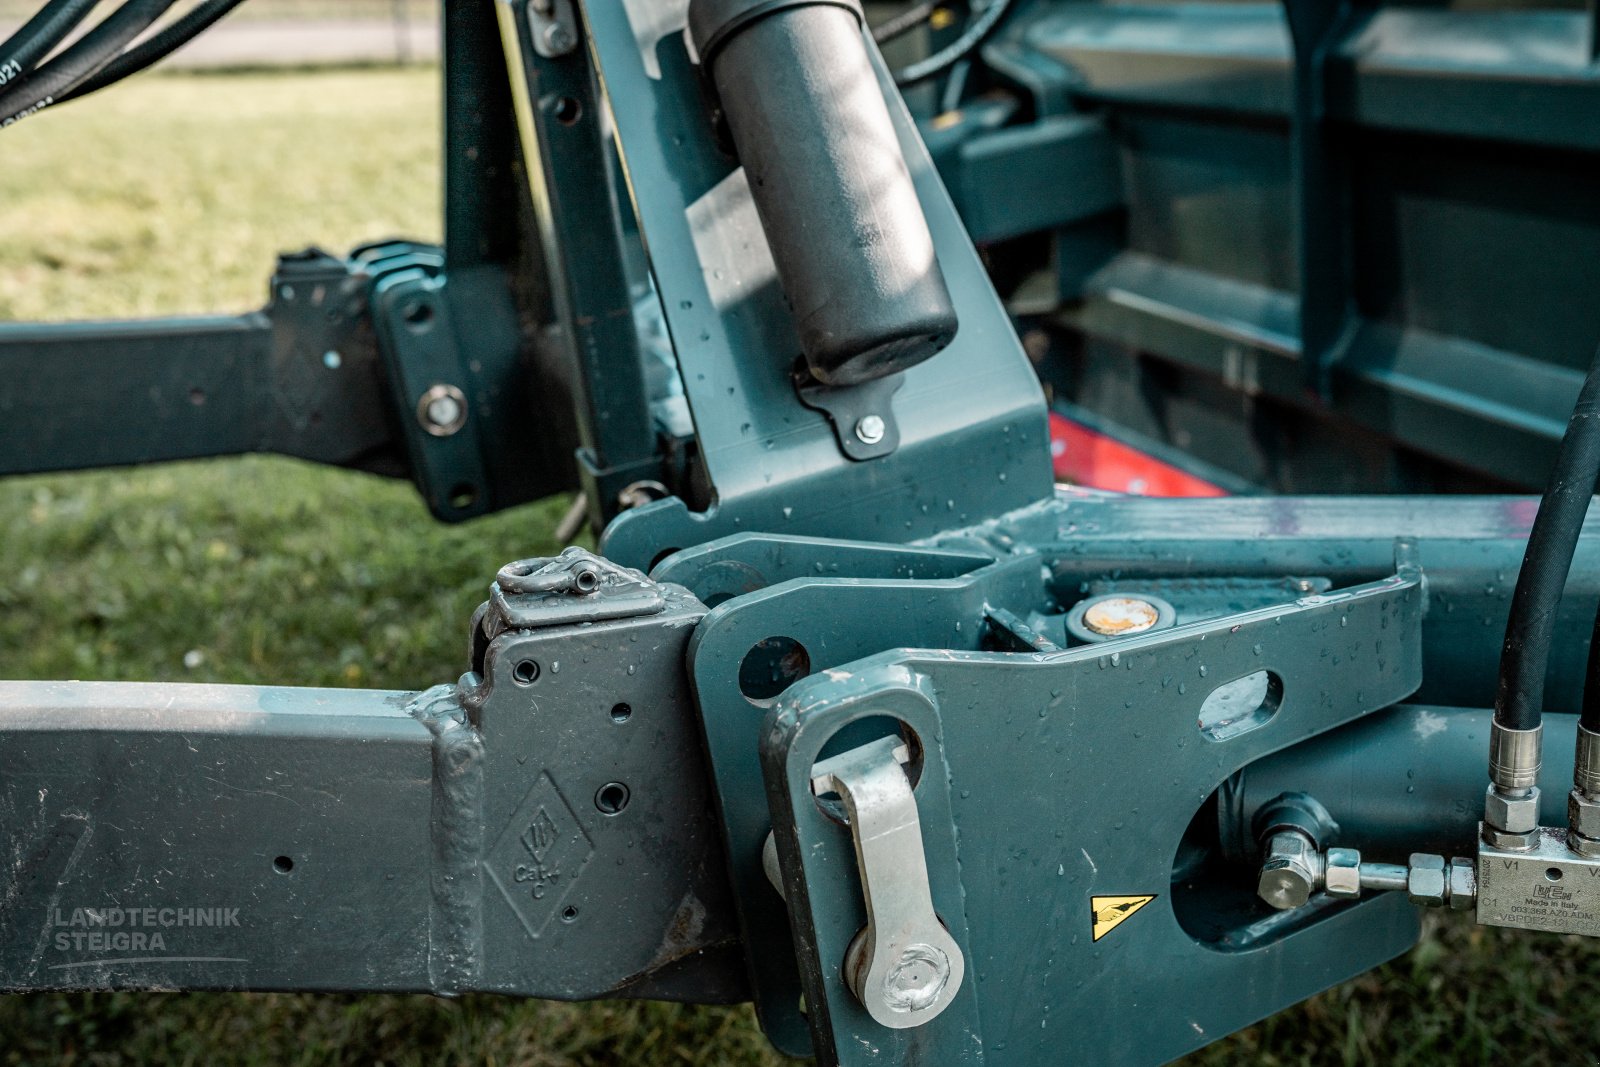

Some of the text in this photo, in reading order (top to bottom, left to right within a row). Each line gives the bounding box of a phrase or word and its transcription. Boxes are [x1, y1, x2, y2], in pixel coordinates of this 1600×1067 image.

[1503, 860, 1518, 870] V1
[1588, 867, 1600, 878] V
[1482, 897, 1497, 907] C1
[1525, 898, 1579, 910] Made in Italy
